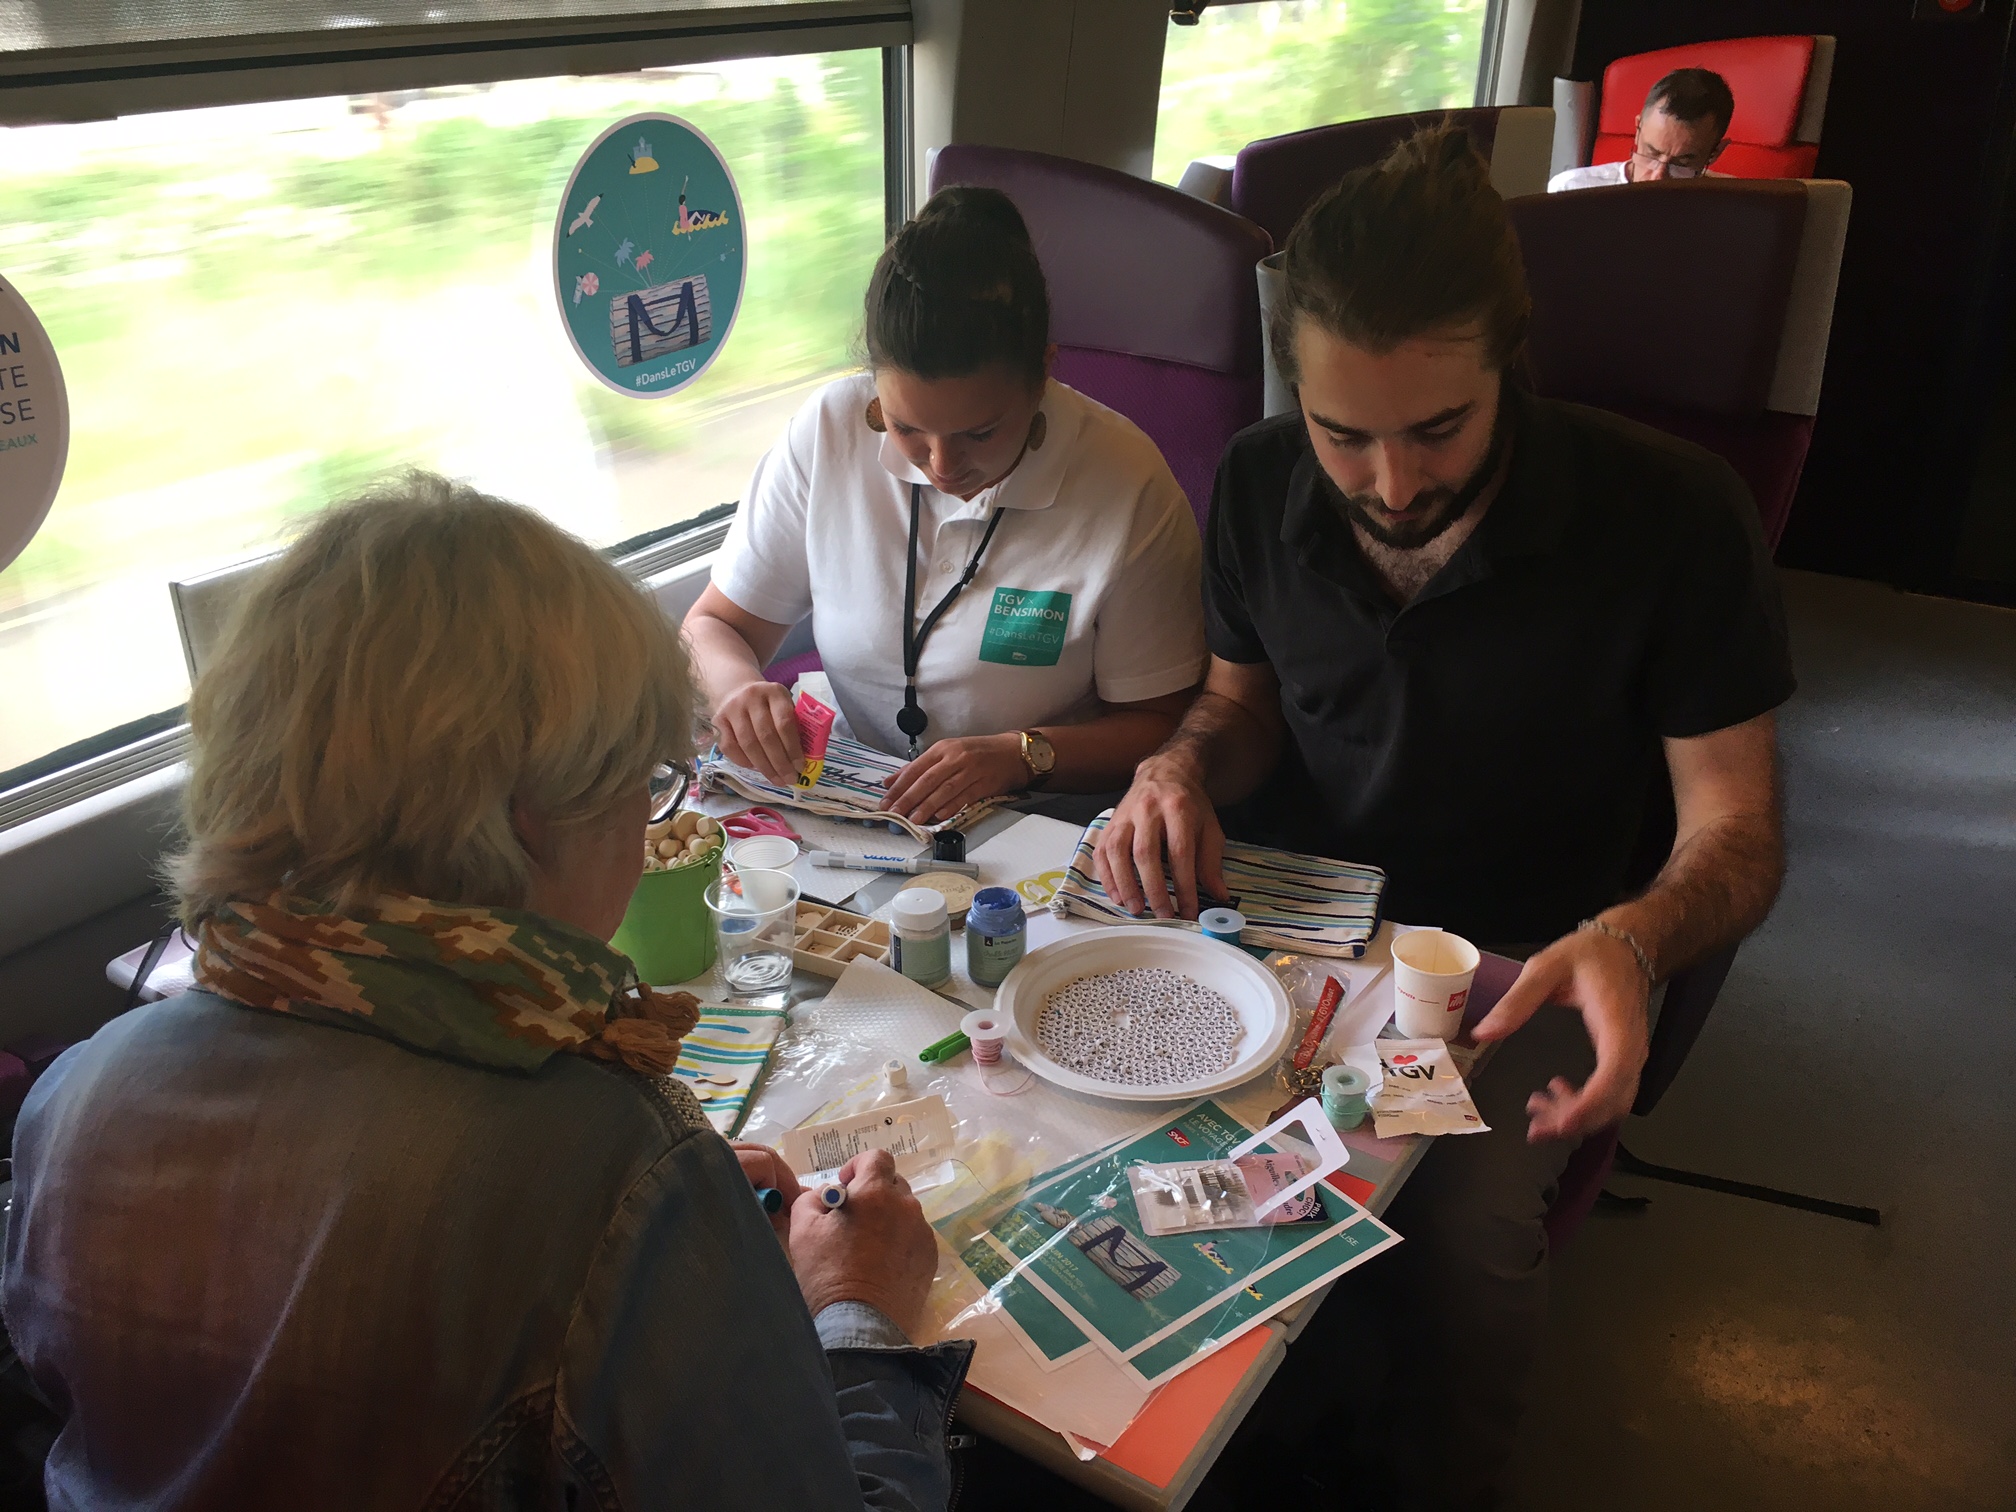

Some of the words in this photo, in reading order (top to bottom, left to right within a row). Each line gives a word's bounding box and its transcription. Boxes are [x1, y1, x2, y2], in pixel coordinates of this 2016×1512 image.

[635, 358, 696, 387] #DansLeTGV
[998, 593, 1025, 605] TGV
[994, 604, 1064, 621] BENSIMON
[989, 627, 1060, 644] #DansLeTGV
[1197, 1113, 1222, 1131] AVEC
[1221, 1129, 1241, 1144] TGV
[1167, 1129, 1190, 1146] SNCF
[1297, 1196, 1314, 1216] CHOC!
[1307, 1202, 1322, 1219] PRIX
